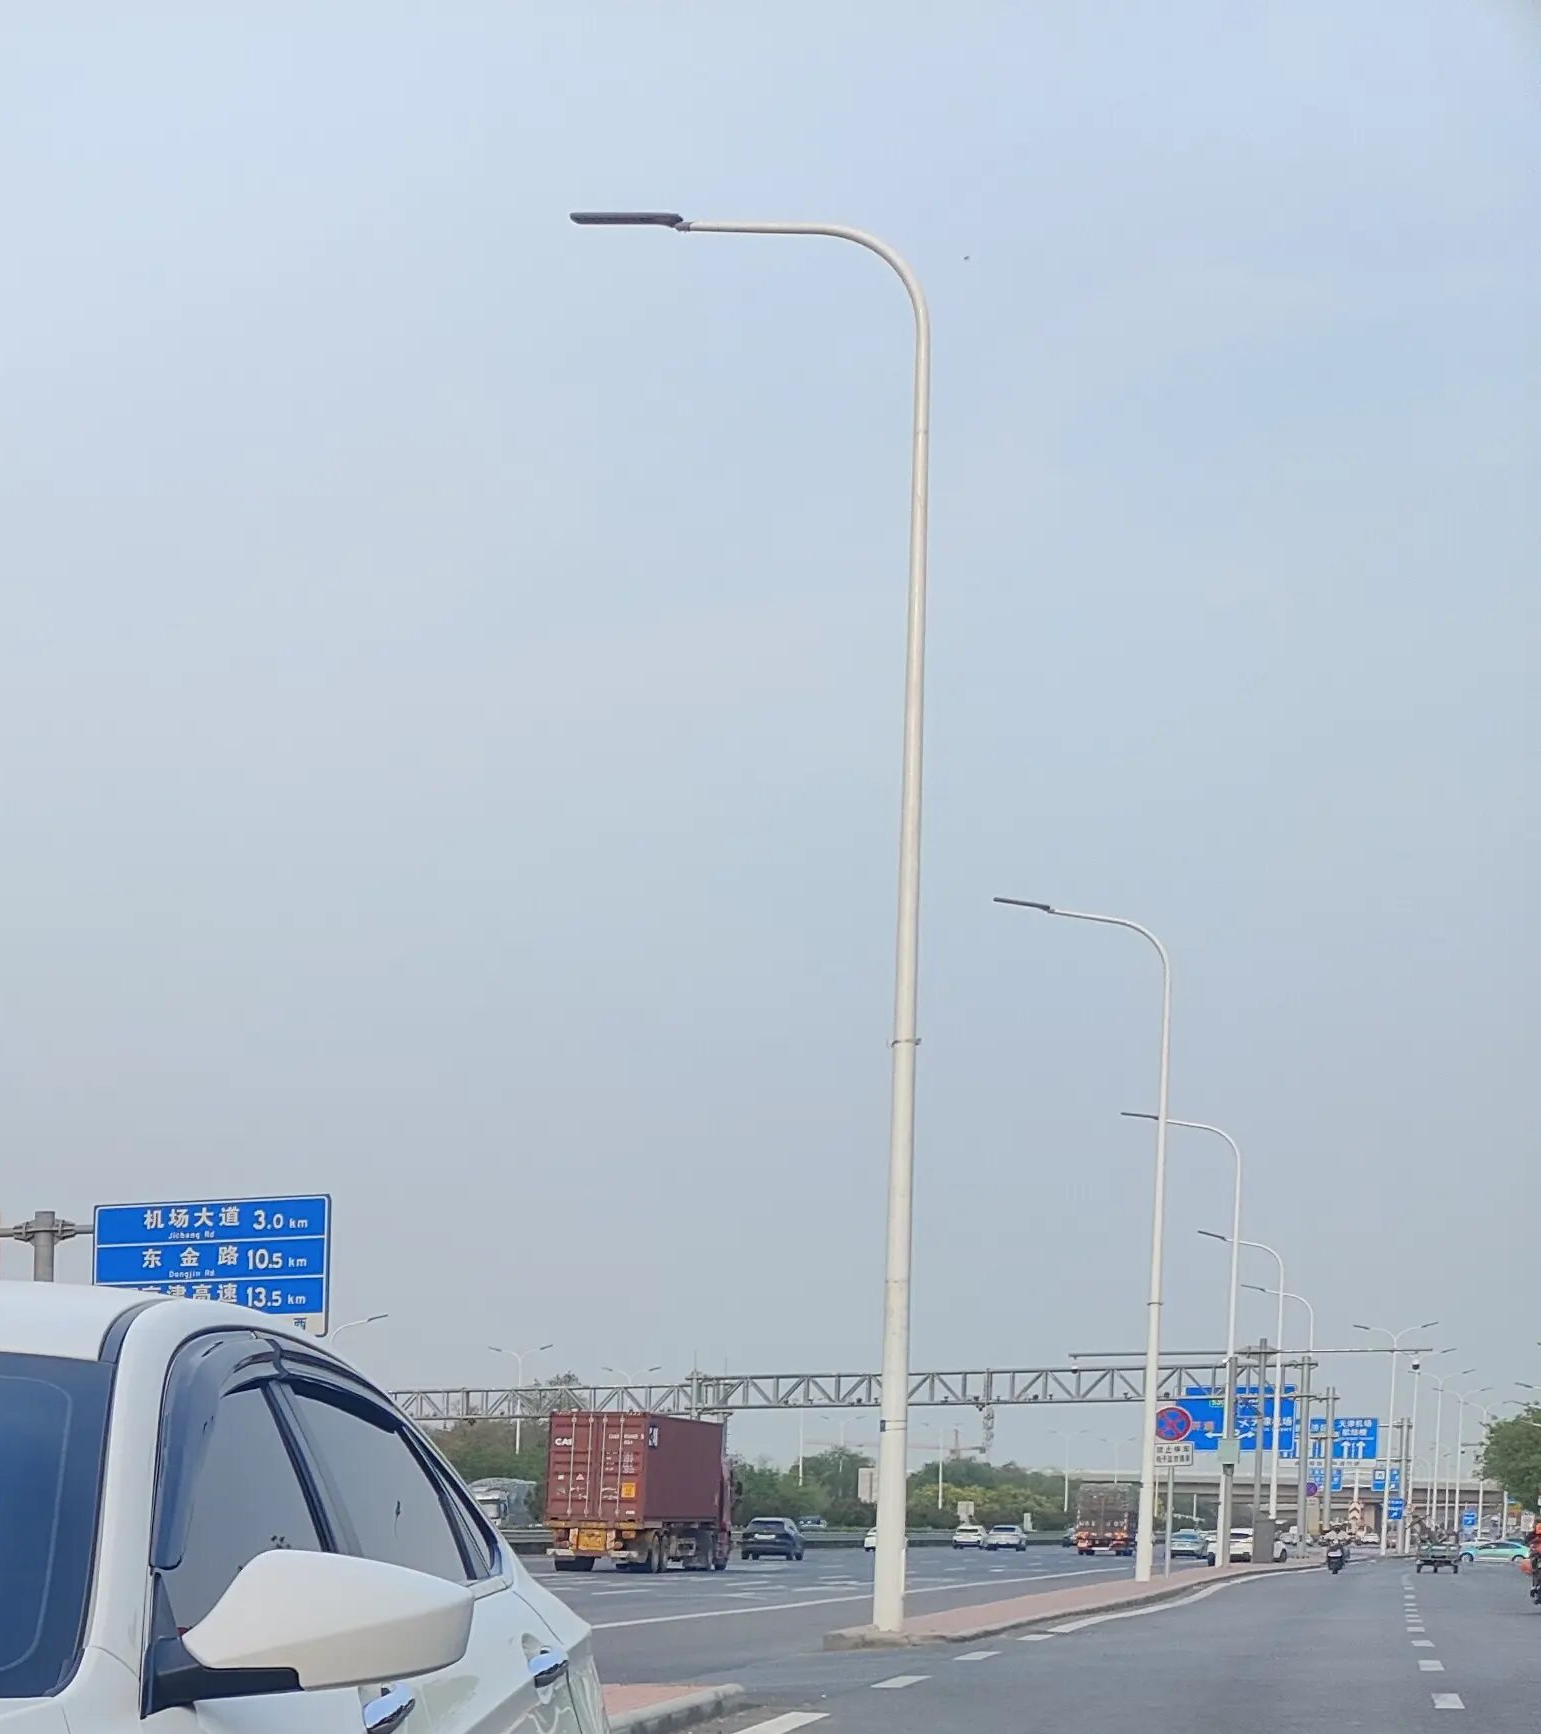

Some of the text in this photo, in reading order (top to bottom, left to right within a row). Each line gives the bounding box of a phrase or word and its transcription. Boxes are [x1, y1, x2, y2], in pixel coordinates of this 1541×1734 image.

[143, 1206, 308, 1230] 机场大道 3.0 km
[168, 1230, 215, 1240] Jichang Rd
[141, 1245, 307, 1270] 东金路 10.5 km
[168, 1269, 215, 1280] Dongjin Rd
[246, 1285, 282, 1308] 13.5
[287, 1293, 306, 1305] km
